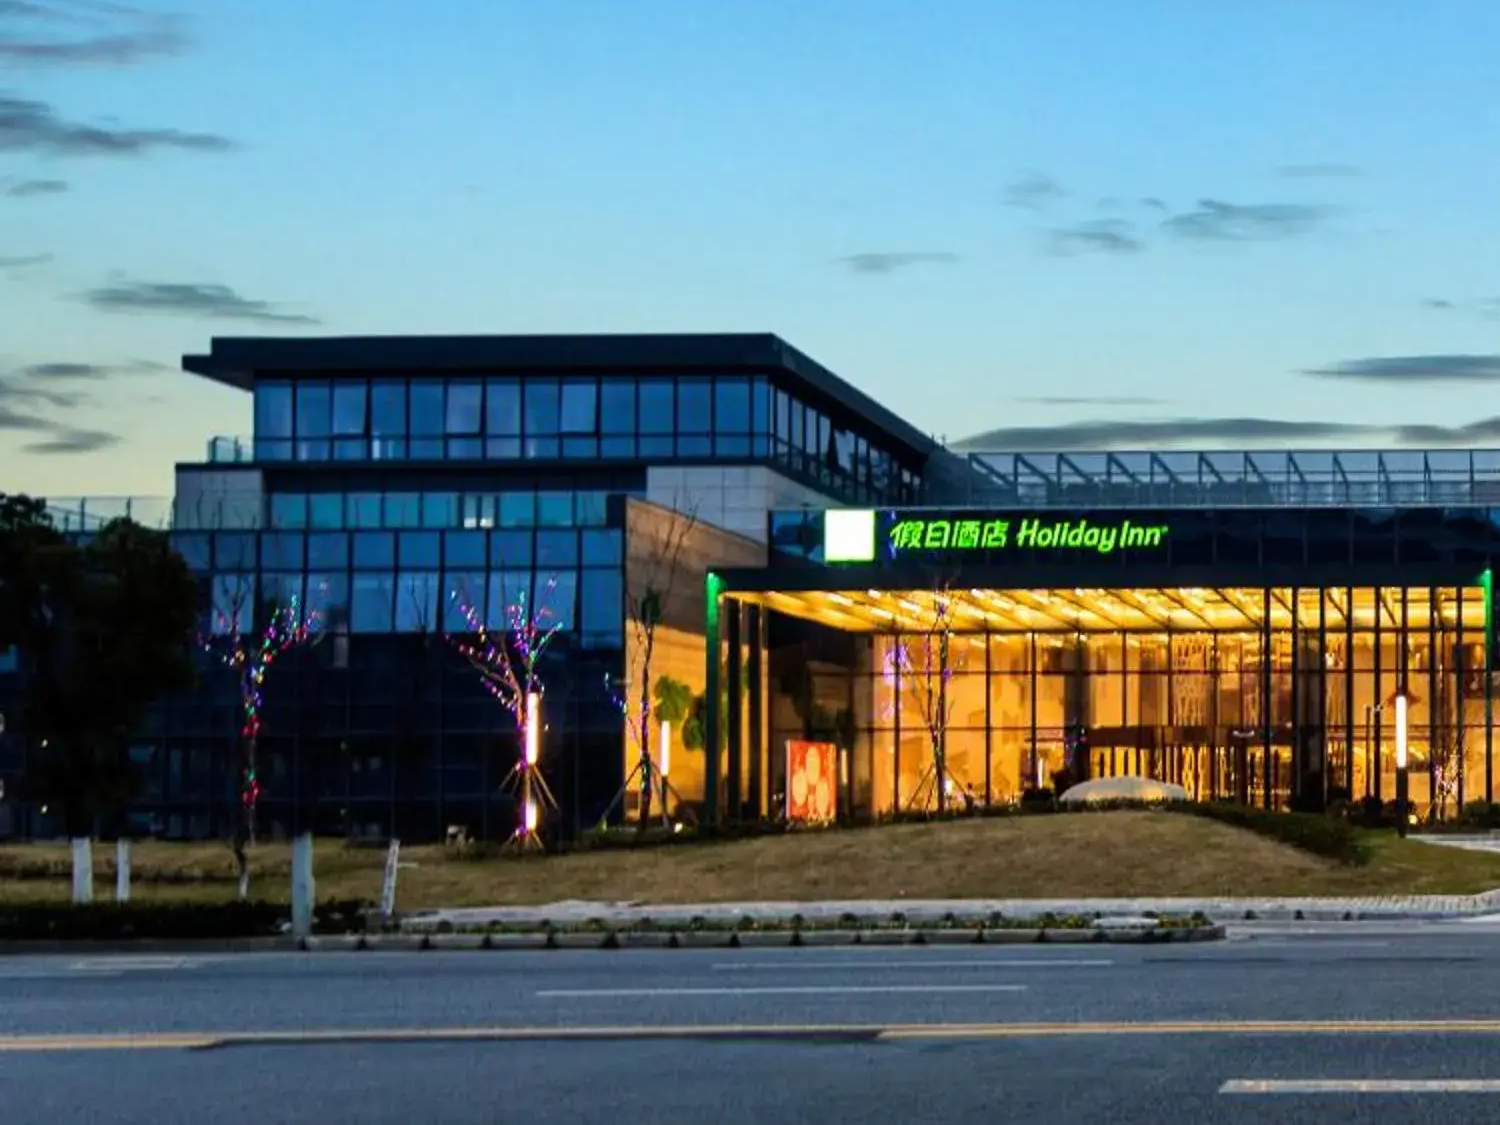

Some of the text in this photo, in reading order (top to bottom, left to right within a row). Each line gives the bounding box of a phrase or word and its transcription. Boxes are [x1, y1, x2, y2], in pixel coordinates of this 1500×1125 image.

[889, 520, 1009, 548] 假日酒店
[1016, 518, 1117, 553] Holiday
